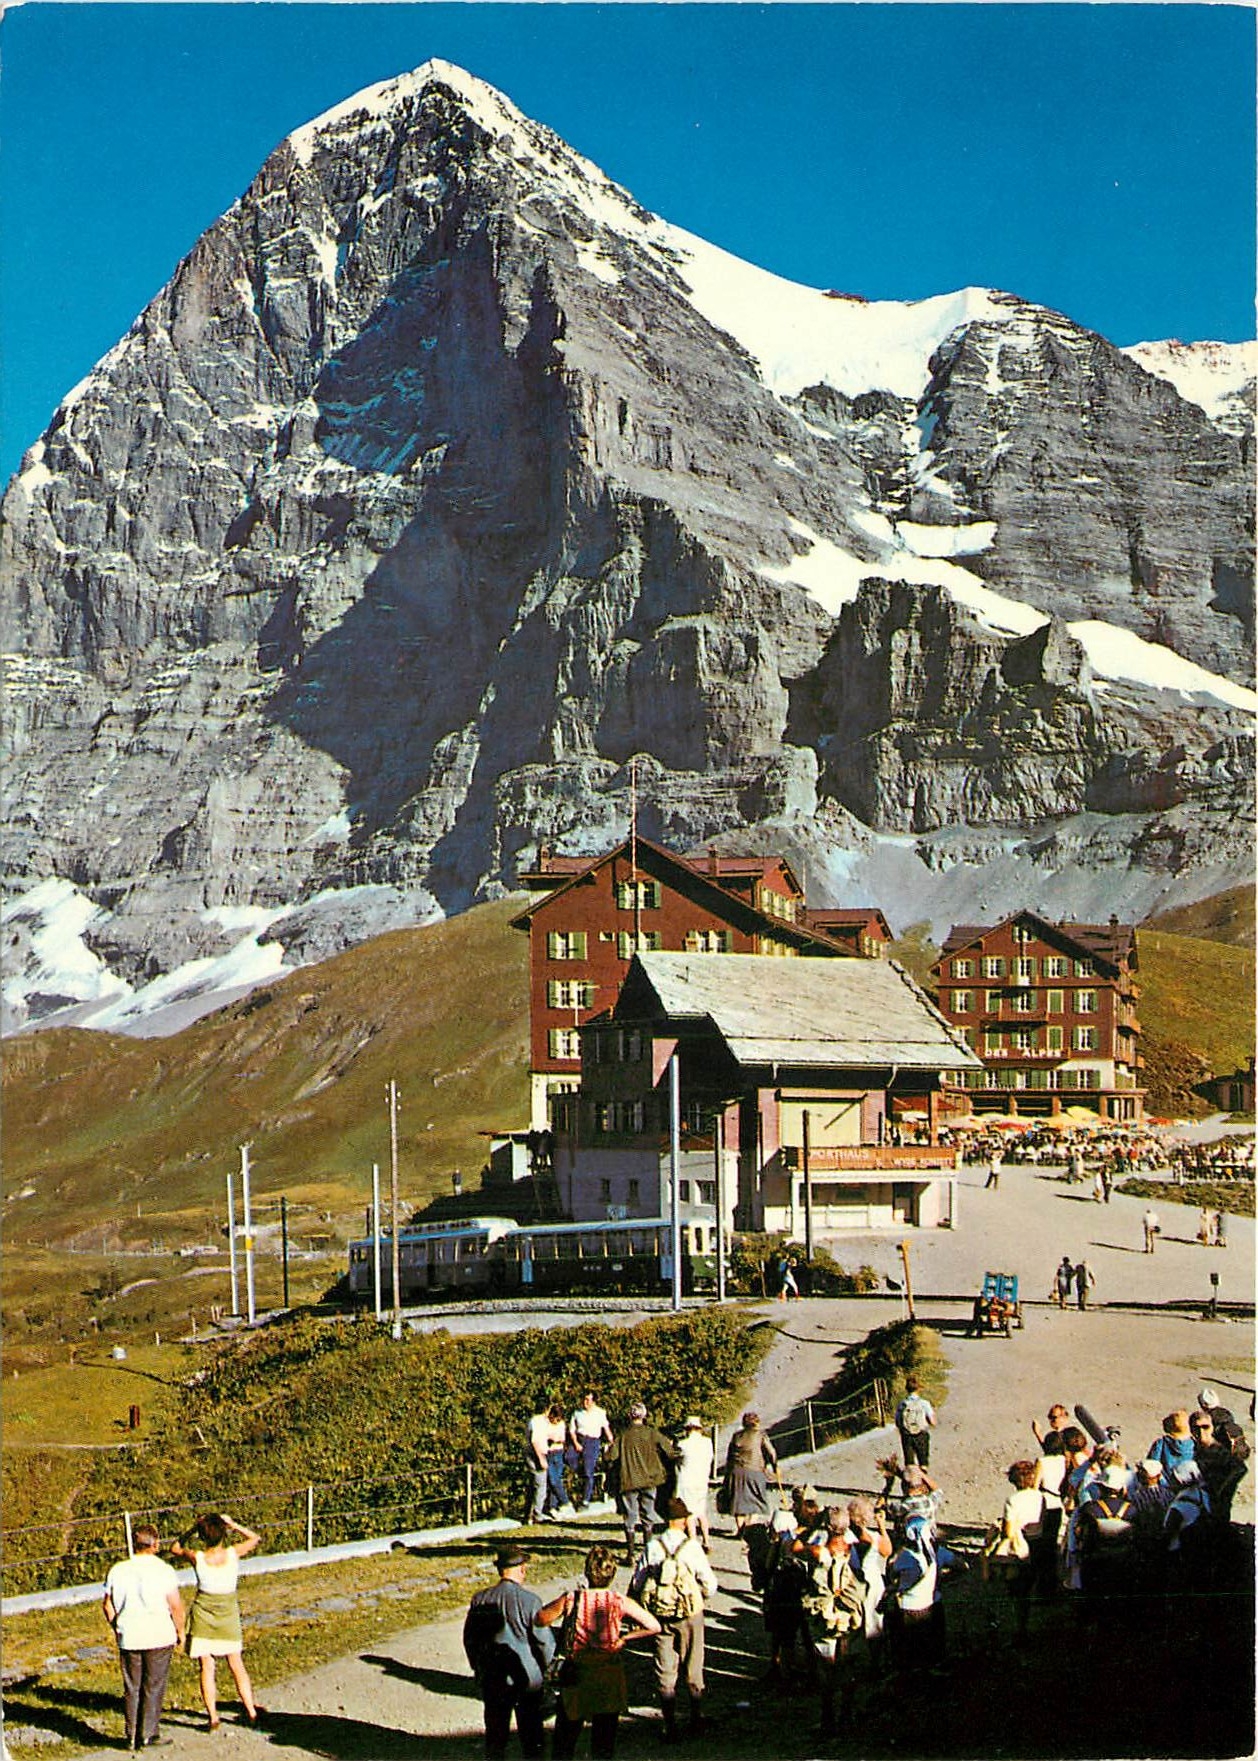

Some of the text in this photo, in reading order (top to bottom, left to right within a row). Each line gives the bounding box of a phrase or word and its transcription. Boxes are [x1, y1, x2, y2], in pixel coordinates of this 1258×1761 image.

[985, 1048, 1061, 1058] DES ALPES
[808, 1149, 869, 1160] PORTHAUS
